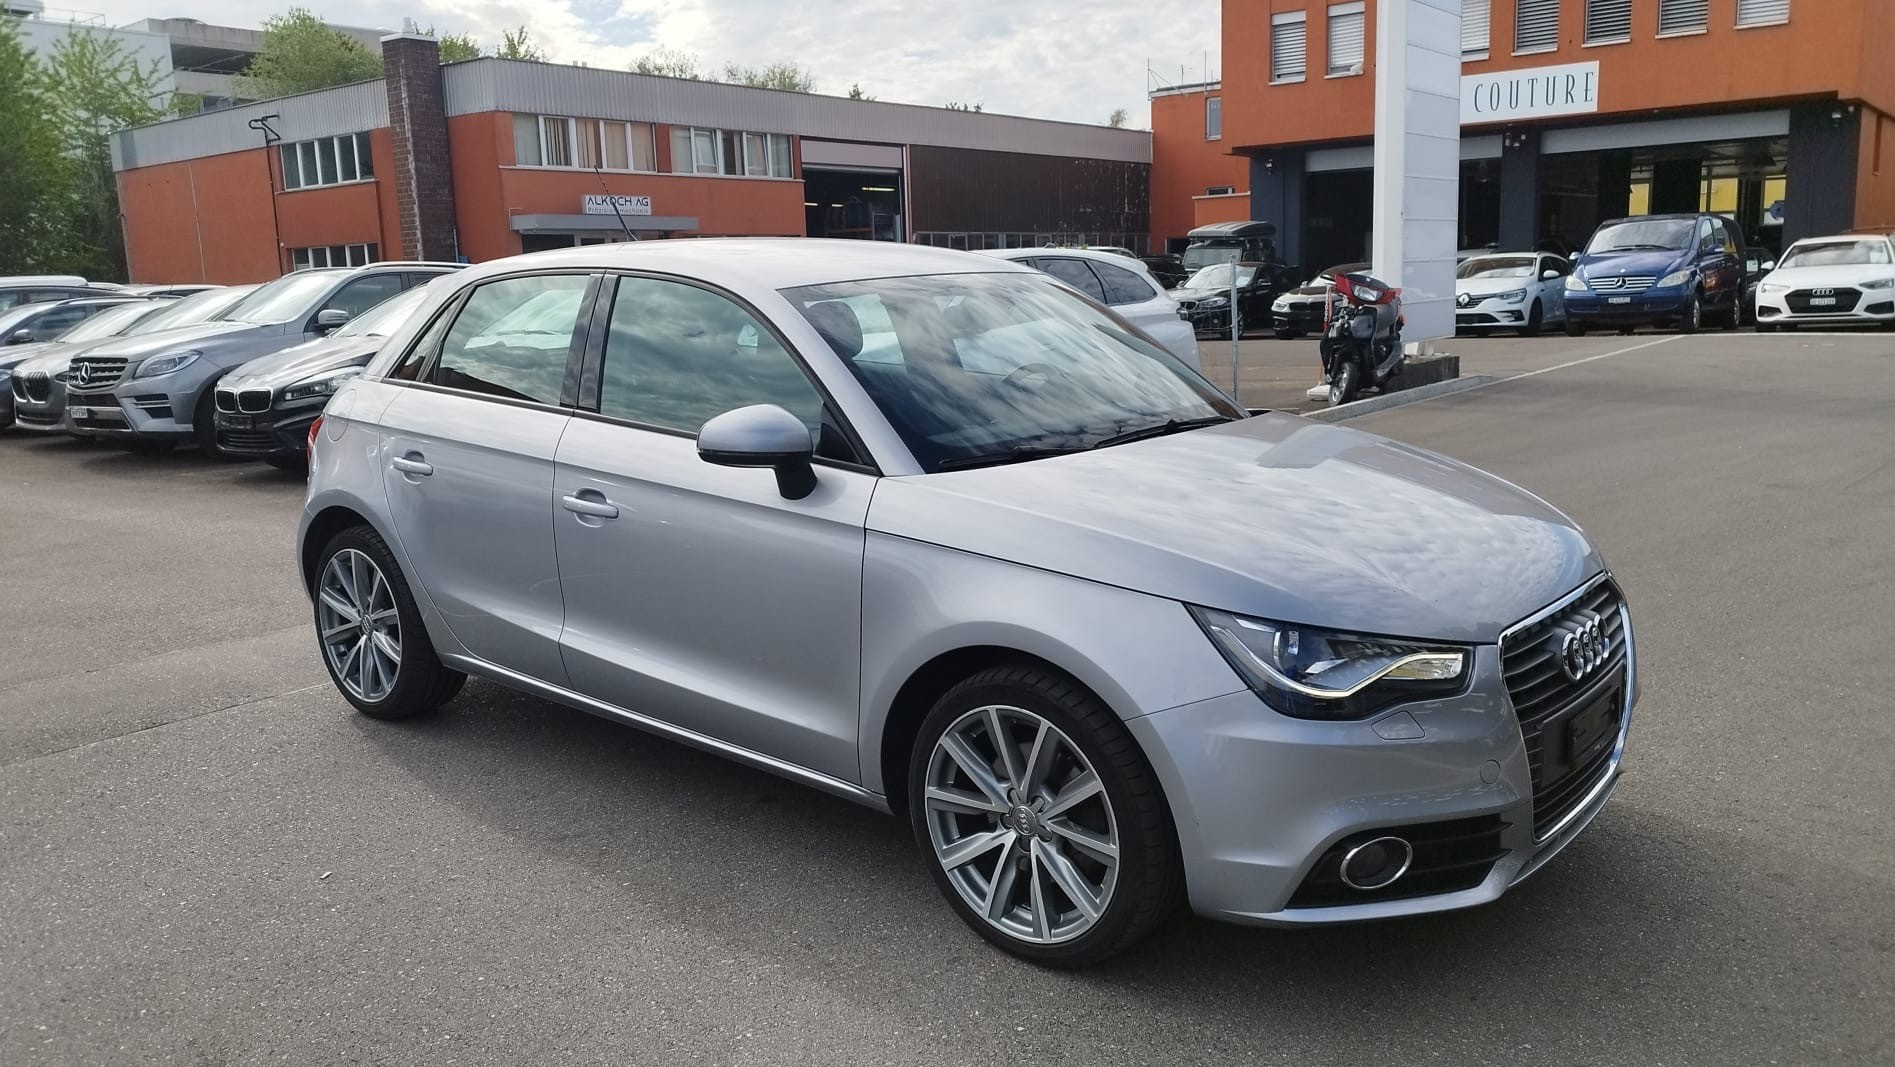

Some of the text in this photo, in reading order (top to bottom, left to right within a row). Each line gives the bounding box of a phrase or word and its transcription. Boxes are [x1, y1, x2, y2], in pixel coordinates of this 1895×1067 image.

[1473, 71, 1594, 113] COUTURE
[588, 196, 649, 207] ALKOCH AG
